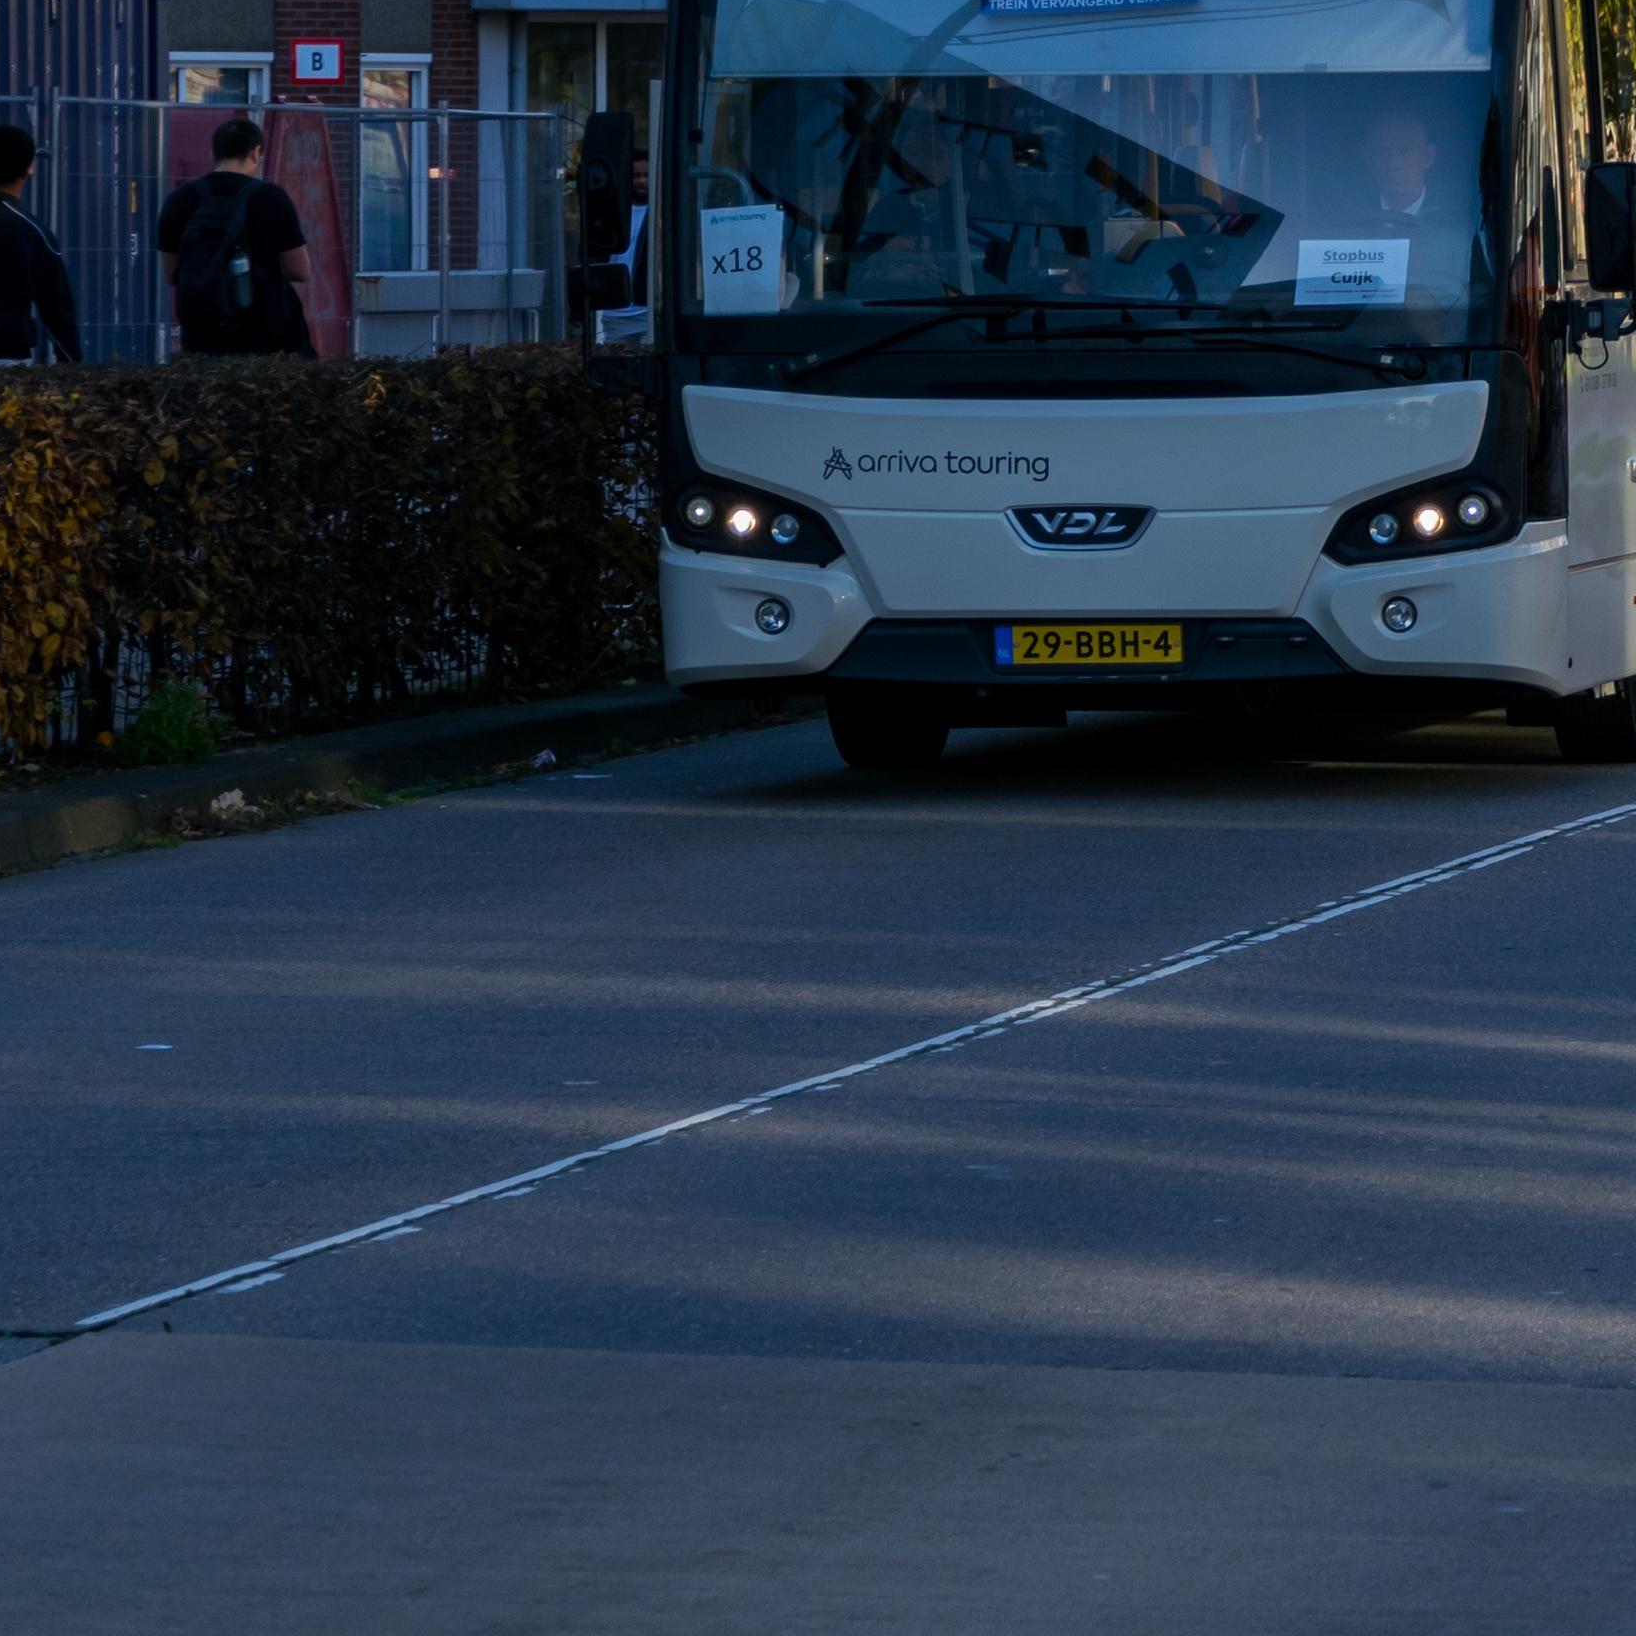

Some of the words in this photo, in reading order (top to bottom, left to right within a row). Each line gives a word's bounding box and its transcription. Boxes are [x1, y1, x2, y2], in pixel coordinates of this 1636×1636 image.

[311, 51, 323, 71] B
[711, 245, 763, 275] x18
[1322, 249, 1385, 263] Stopbus
[1330, 271, 1373, 286] Cuijk
[857, 450, 938, 474] arriva
[944, 450, 1050, 482] touring
[1031, 512, 1127, 536] VDL
[997, 649, 1011, 659] NL
[1022, 630, 1173, 660] 29-BBH-4
